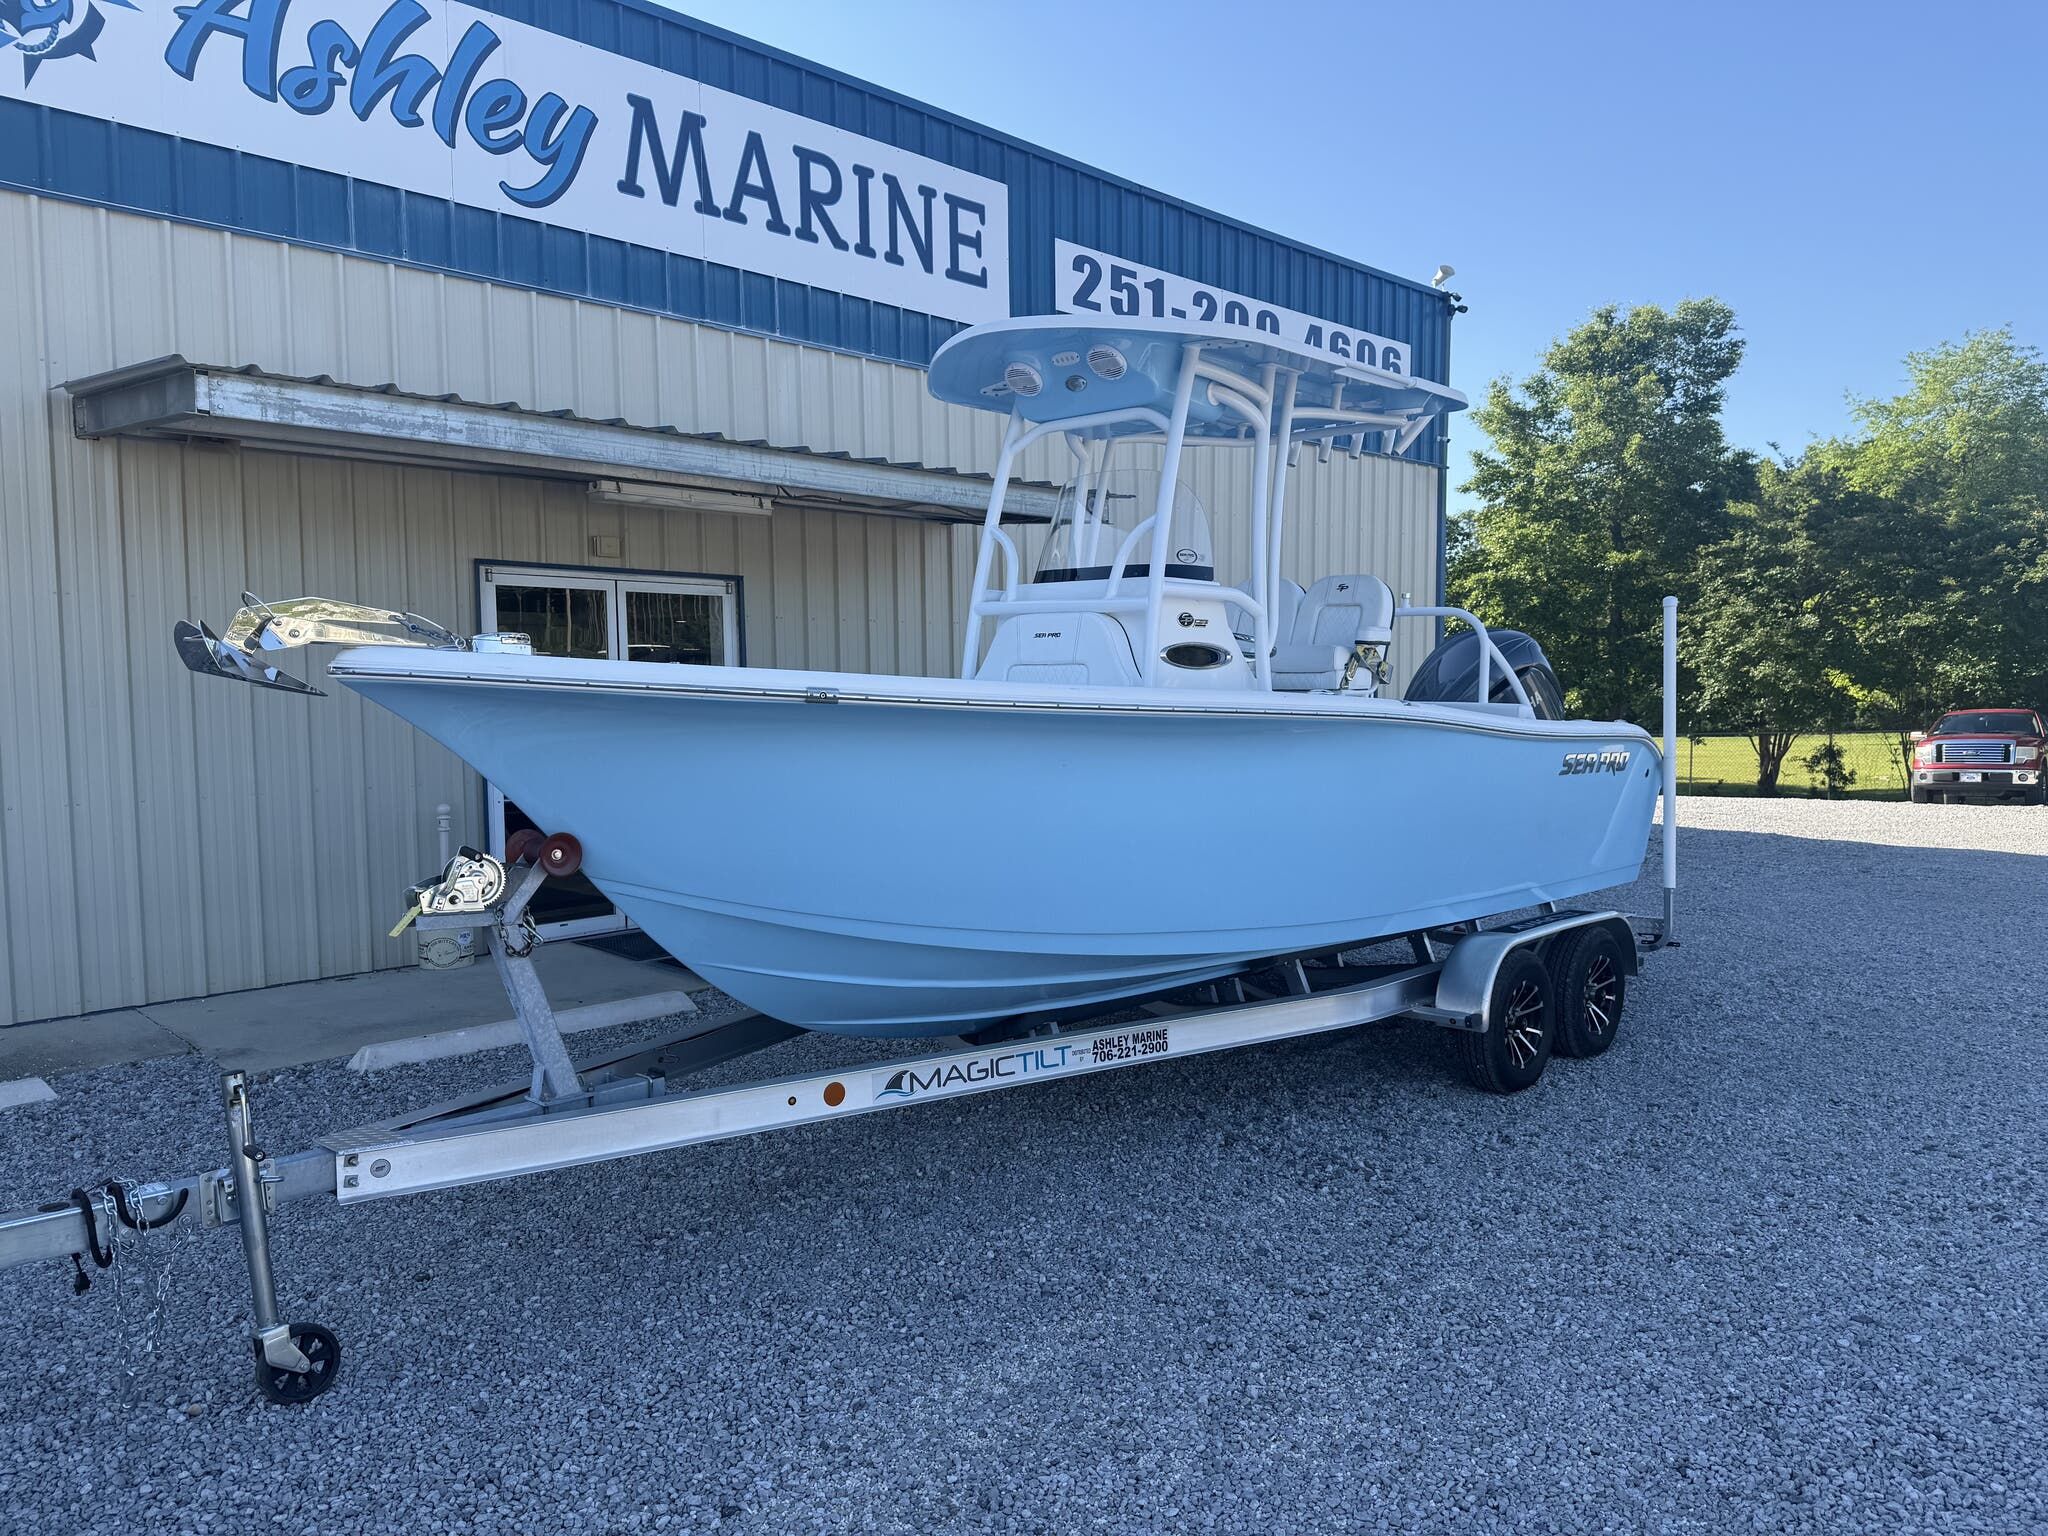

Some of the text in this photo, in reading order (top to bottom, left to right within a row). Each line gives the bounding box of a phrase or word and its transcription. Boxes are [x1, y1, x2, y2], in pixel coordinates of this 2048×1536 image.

[164, 0, 988, 289] Ashley MARINE
[1559, 751, 1631, 776] SEA PRO
[1092, 1029, 1168, 1052] ASHLEY MARINE
[1092, 1040, 1168, 1063] 706-221-2900
[909, 1045, 1073, 1093] MAGICTILT
